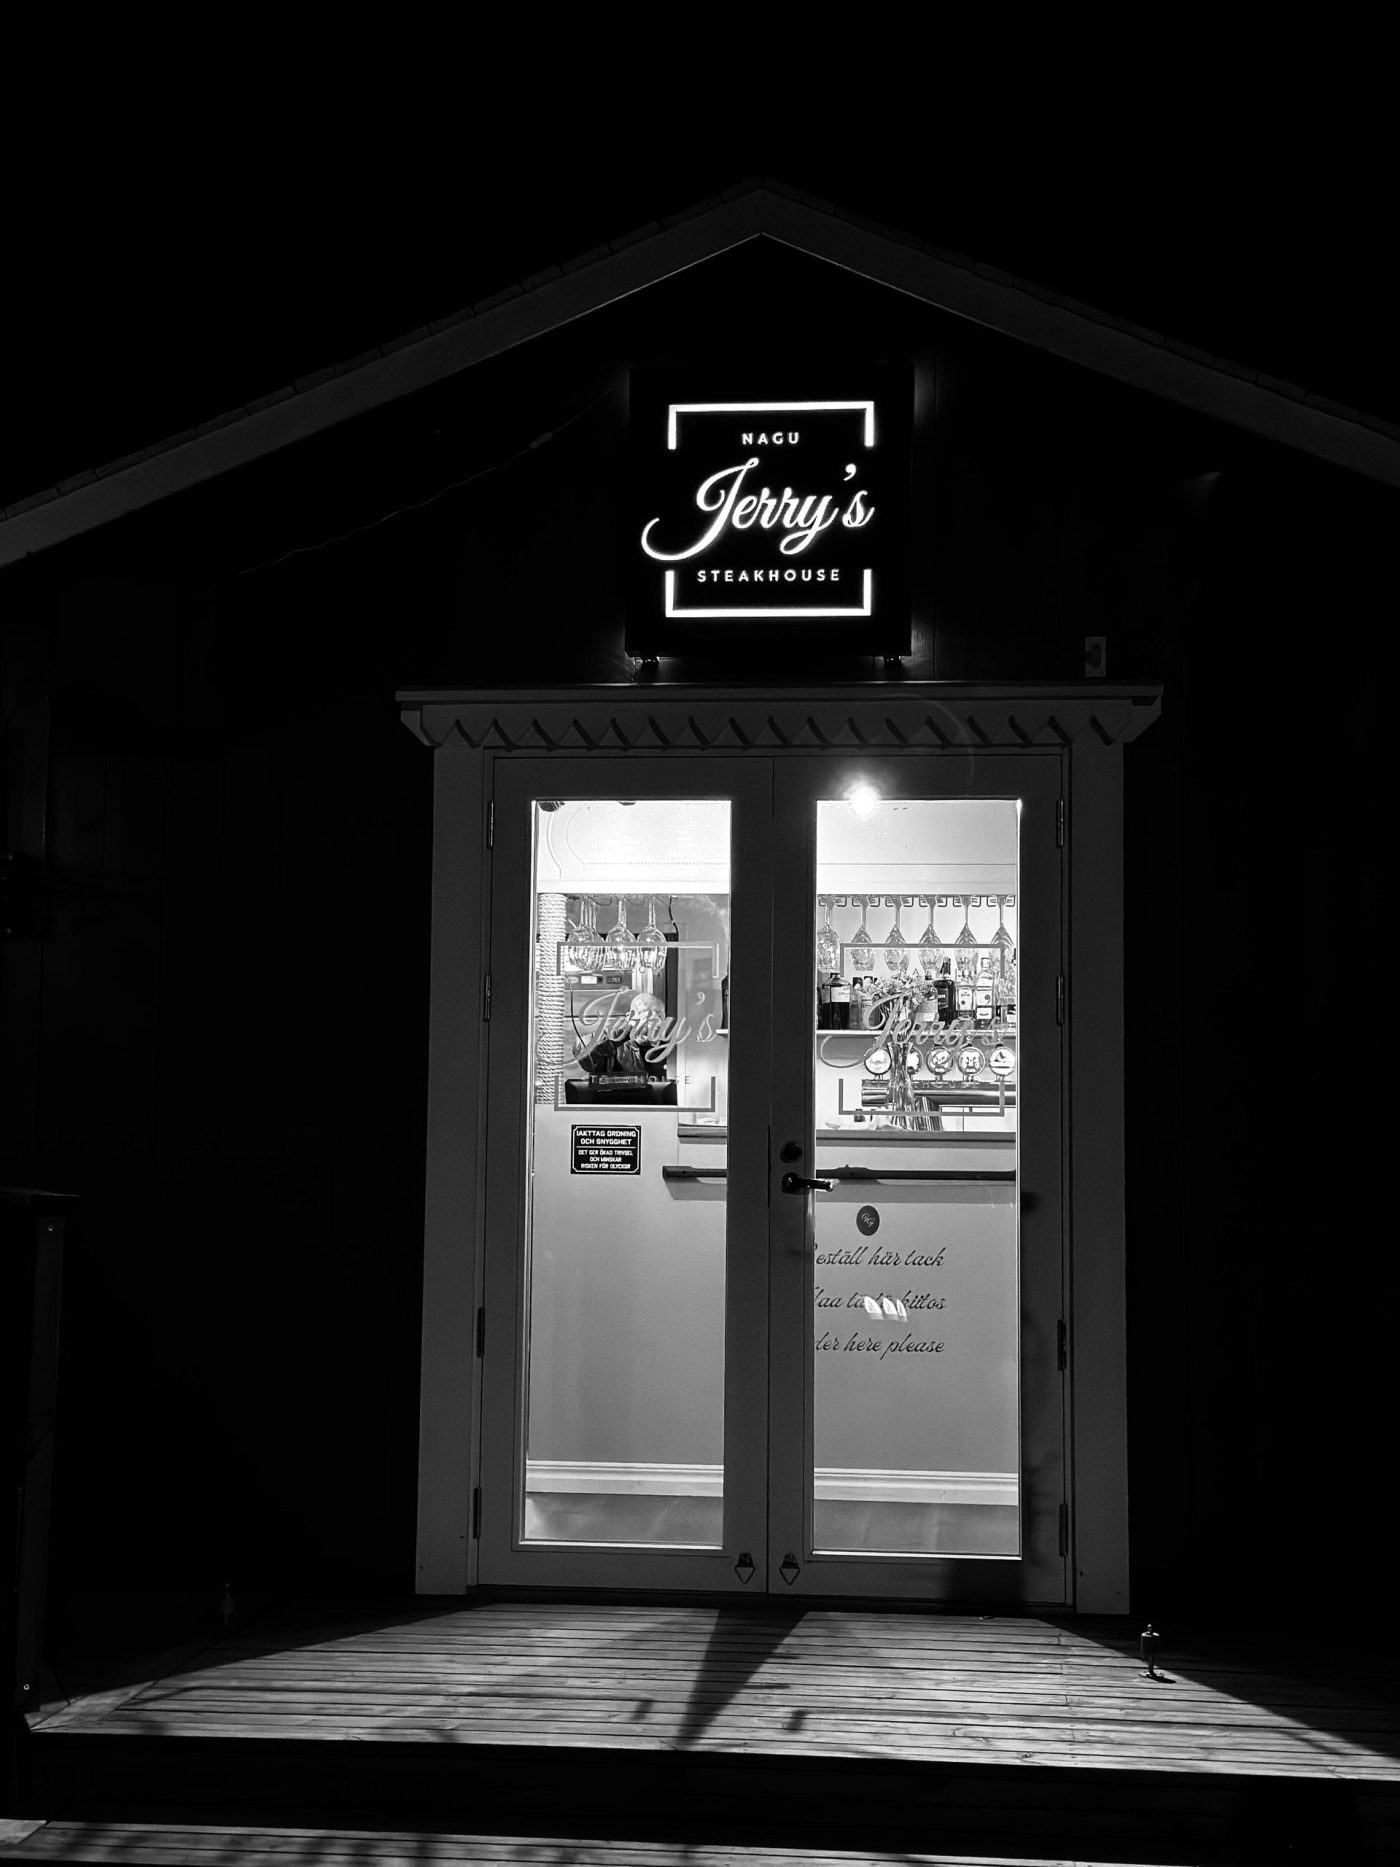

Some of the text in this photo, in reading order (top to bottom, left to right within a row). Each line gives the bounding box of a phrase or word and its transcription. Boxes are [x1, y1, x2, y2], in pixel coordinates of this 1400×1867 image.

[742, 432, 800, 445] NAGU
[641, 457, 875, 561] Jerry's
[697, 569, 840, 583] STEAKHOUSE
[606, 1130, 637, 1138] ORDNING
[595, 1138, 632, 1146] SNYGGHET
[814, 1243, 946, 1267] eställ här tack
[843, 1332, 882, 1352] here
[880, 1332, 945, 1361] please
